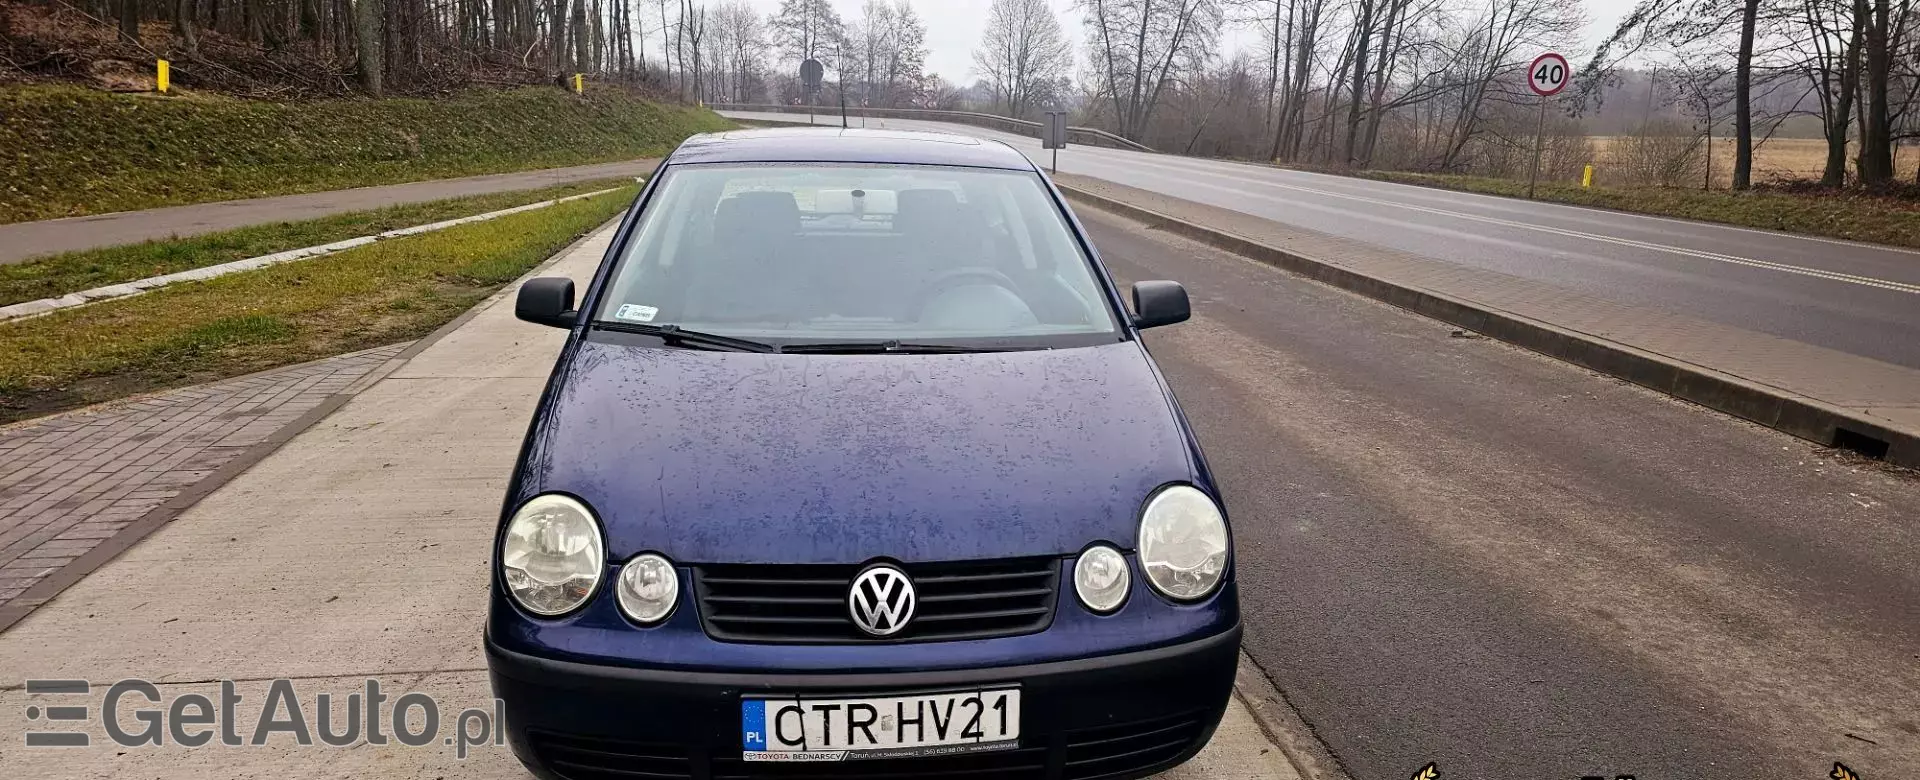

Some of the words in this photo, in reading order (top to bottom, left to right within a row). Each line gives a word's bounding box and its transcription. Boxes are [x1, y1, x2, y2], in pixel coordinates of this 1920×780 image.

[1534, 64, 1564, 84] 40
[850, 568, 915, 635] VW
[746, 731, 763, 743] PL
[774, 703, 878, 747] CTR
[897, 694, 1008, 744] HV21
